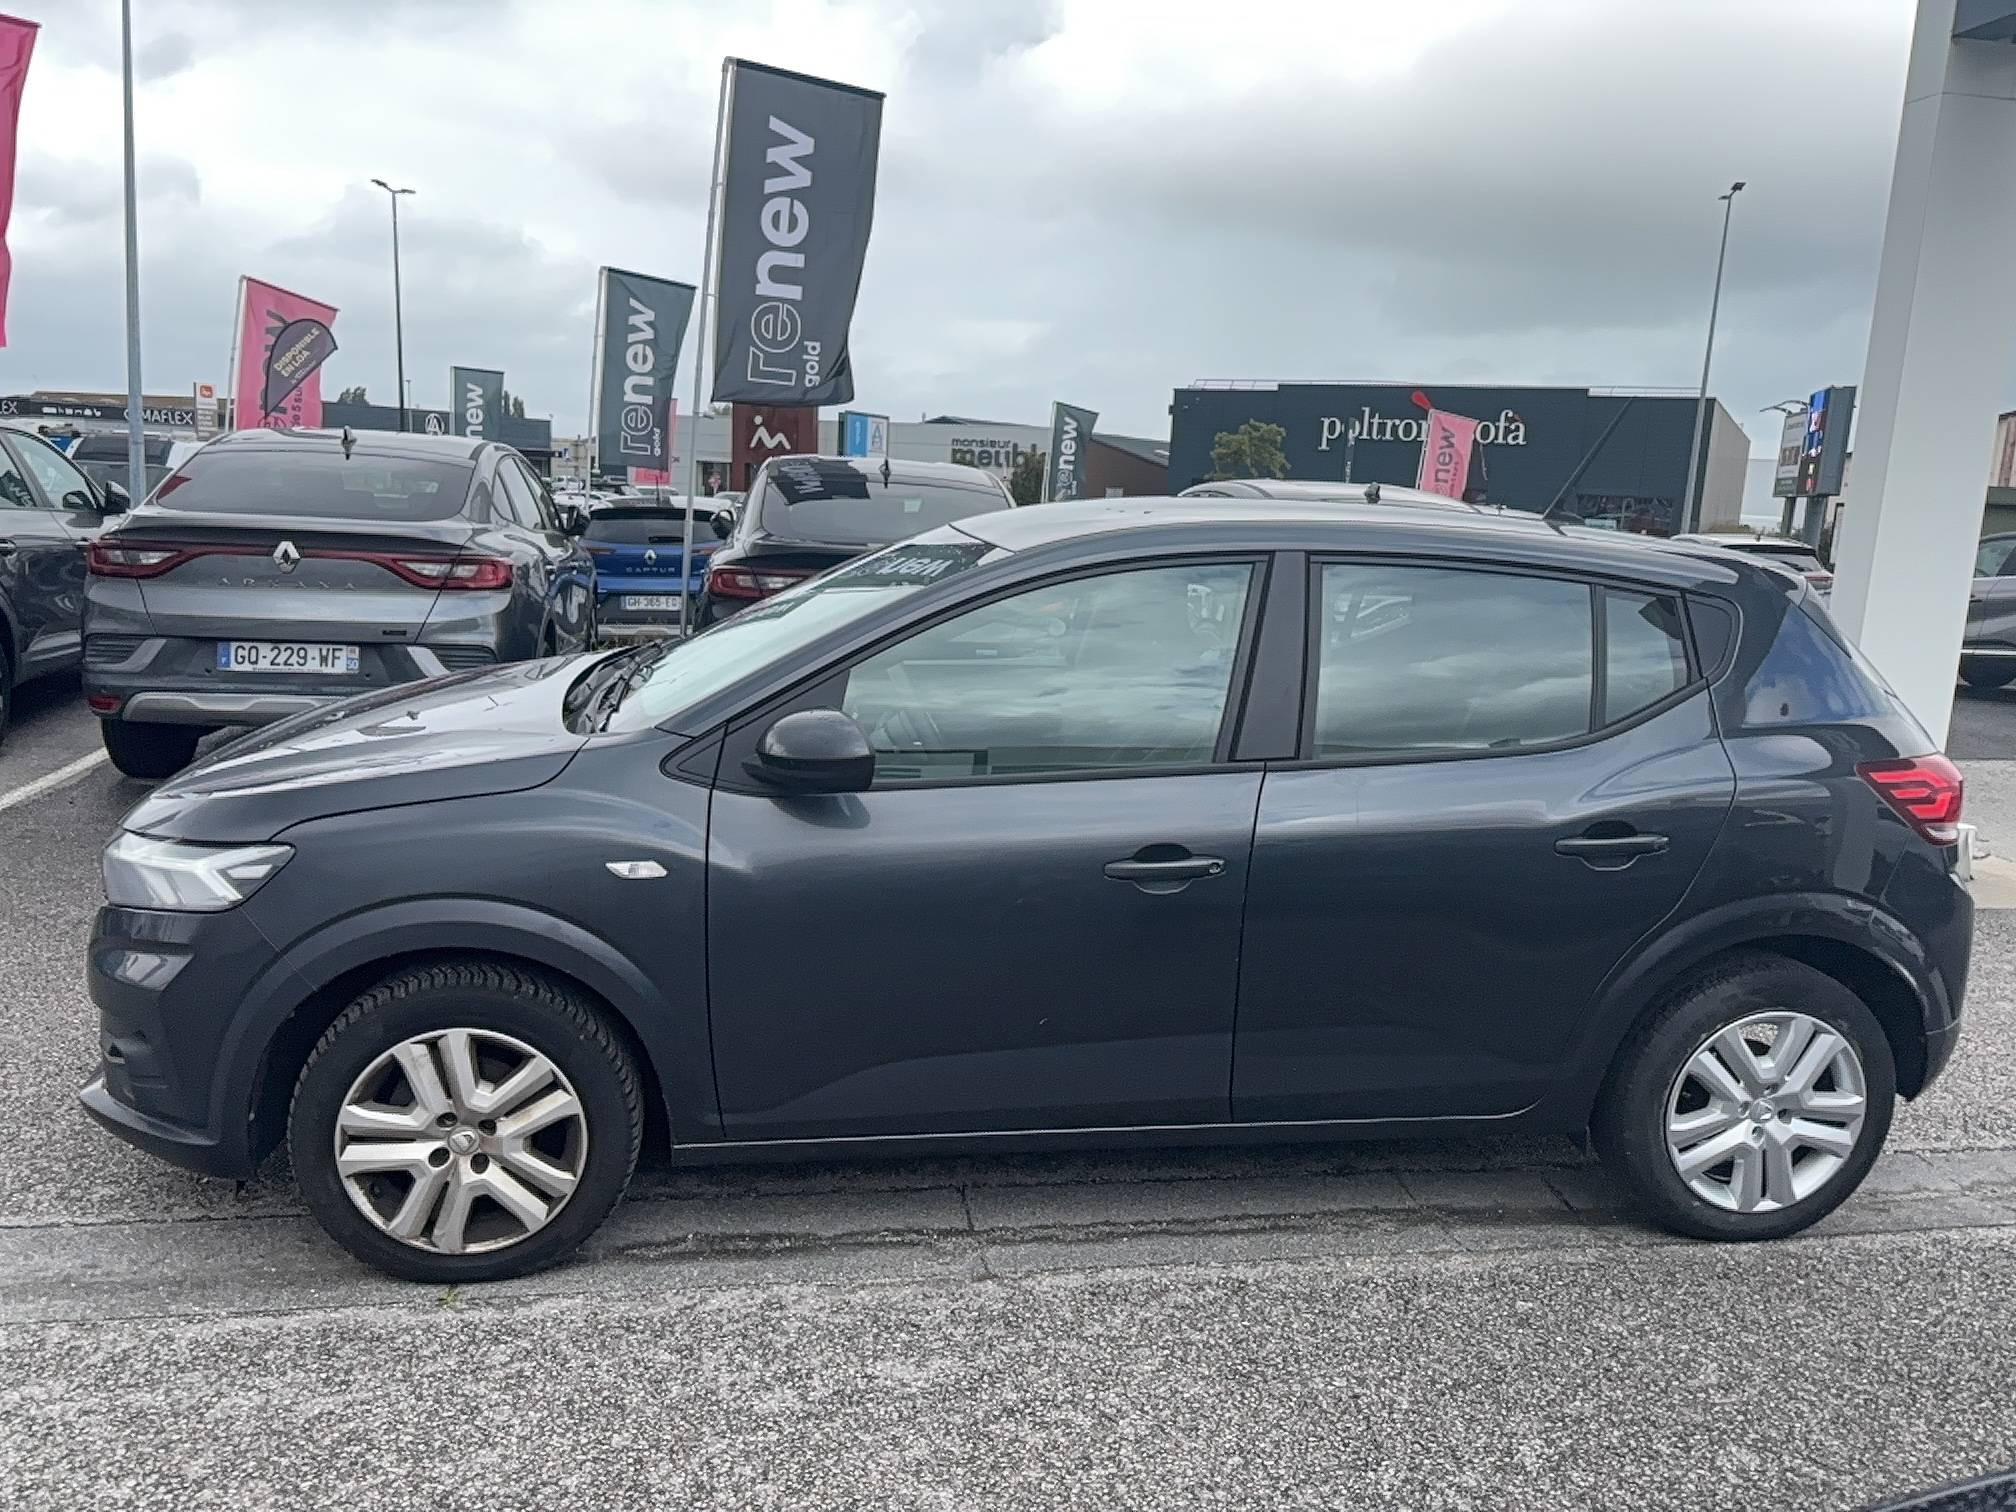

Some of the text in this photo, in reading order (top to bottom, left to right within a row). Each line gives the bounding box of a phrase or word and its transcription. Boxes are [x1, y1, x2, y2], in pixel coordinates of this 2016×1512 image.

[747, 114, 815, 387] renew
[620, 297, 656, 456] renew
[804, 341, 821, 388] gold
[0, 400, 19, 414] EX
[124, 408, 193, 424] CMAFLEX
[465, 383, 483, 439] new
[952, 437, 1011, 448] monsieur
[234, 644, 344, 668] GQ-229-WF
